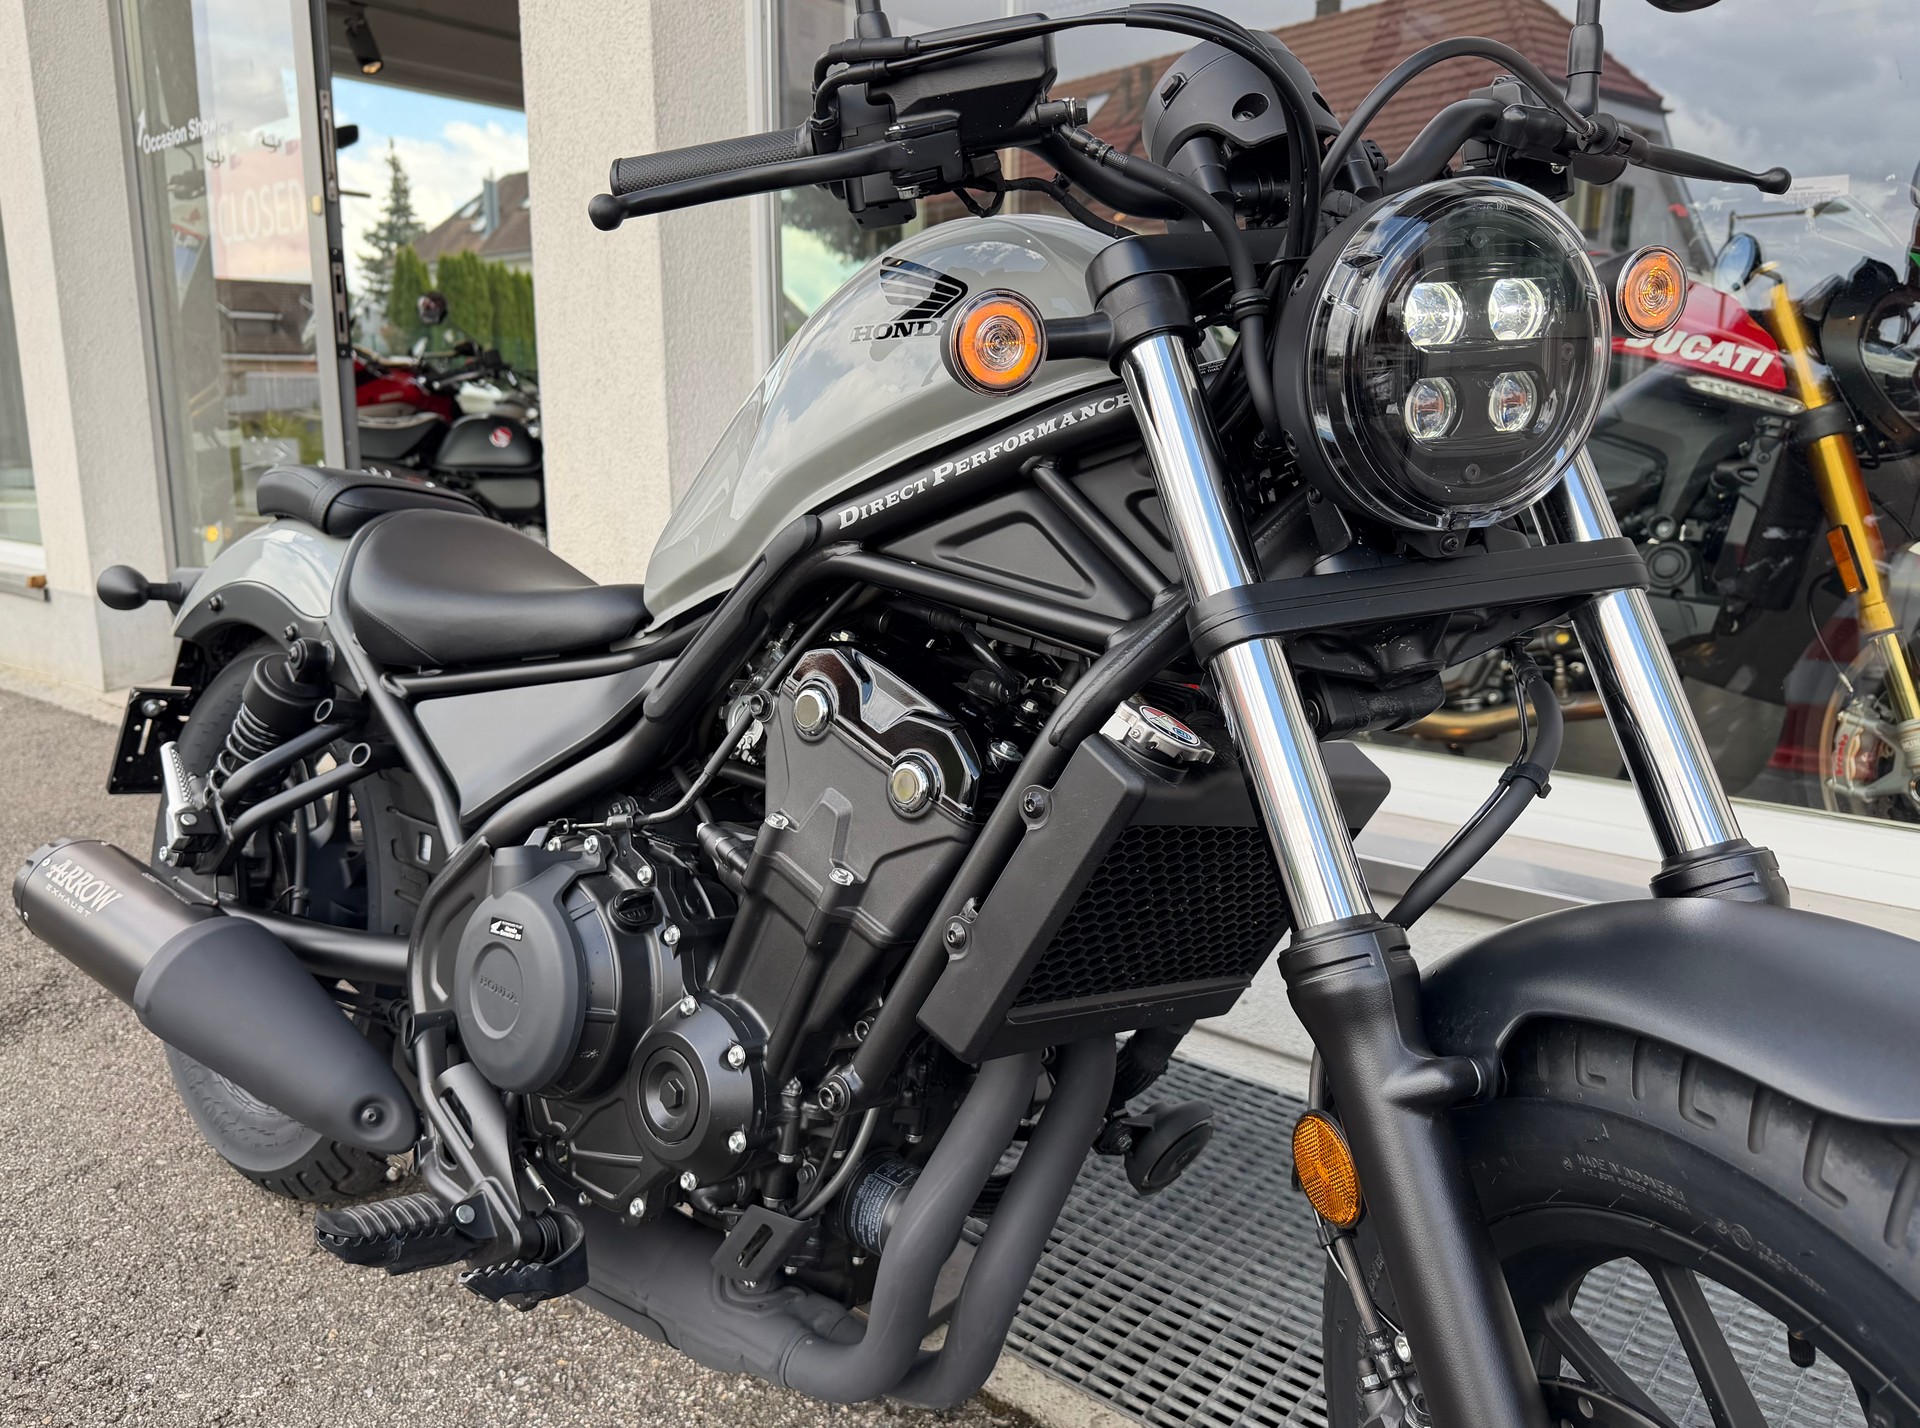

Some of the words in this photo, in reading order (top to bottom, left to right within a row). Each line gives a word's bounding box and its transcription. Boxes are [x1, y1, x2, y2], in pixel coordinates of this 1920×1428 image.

[143, 125, 188, 154] Occasion
[218, 178, 305, 245] CLOSED
[838, 477, 928, 530] DIRECT
[932, 392, 1131, 487] PERFORMANCE
[45, 858, 124, 912] ARROW
[45, 883, 91, 917] EXHAUST
